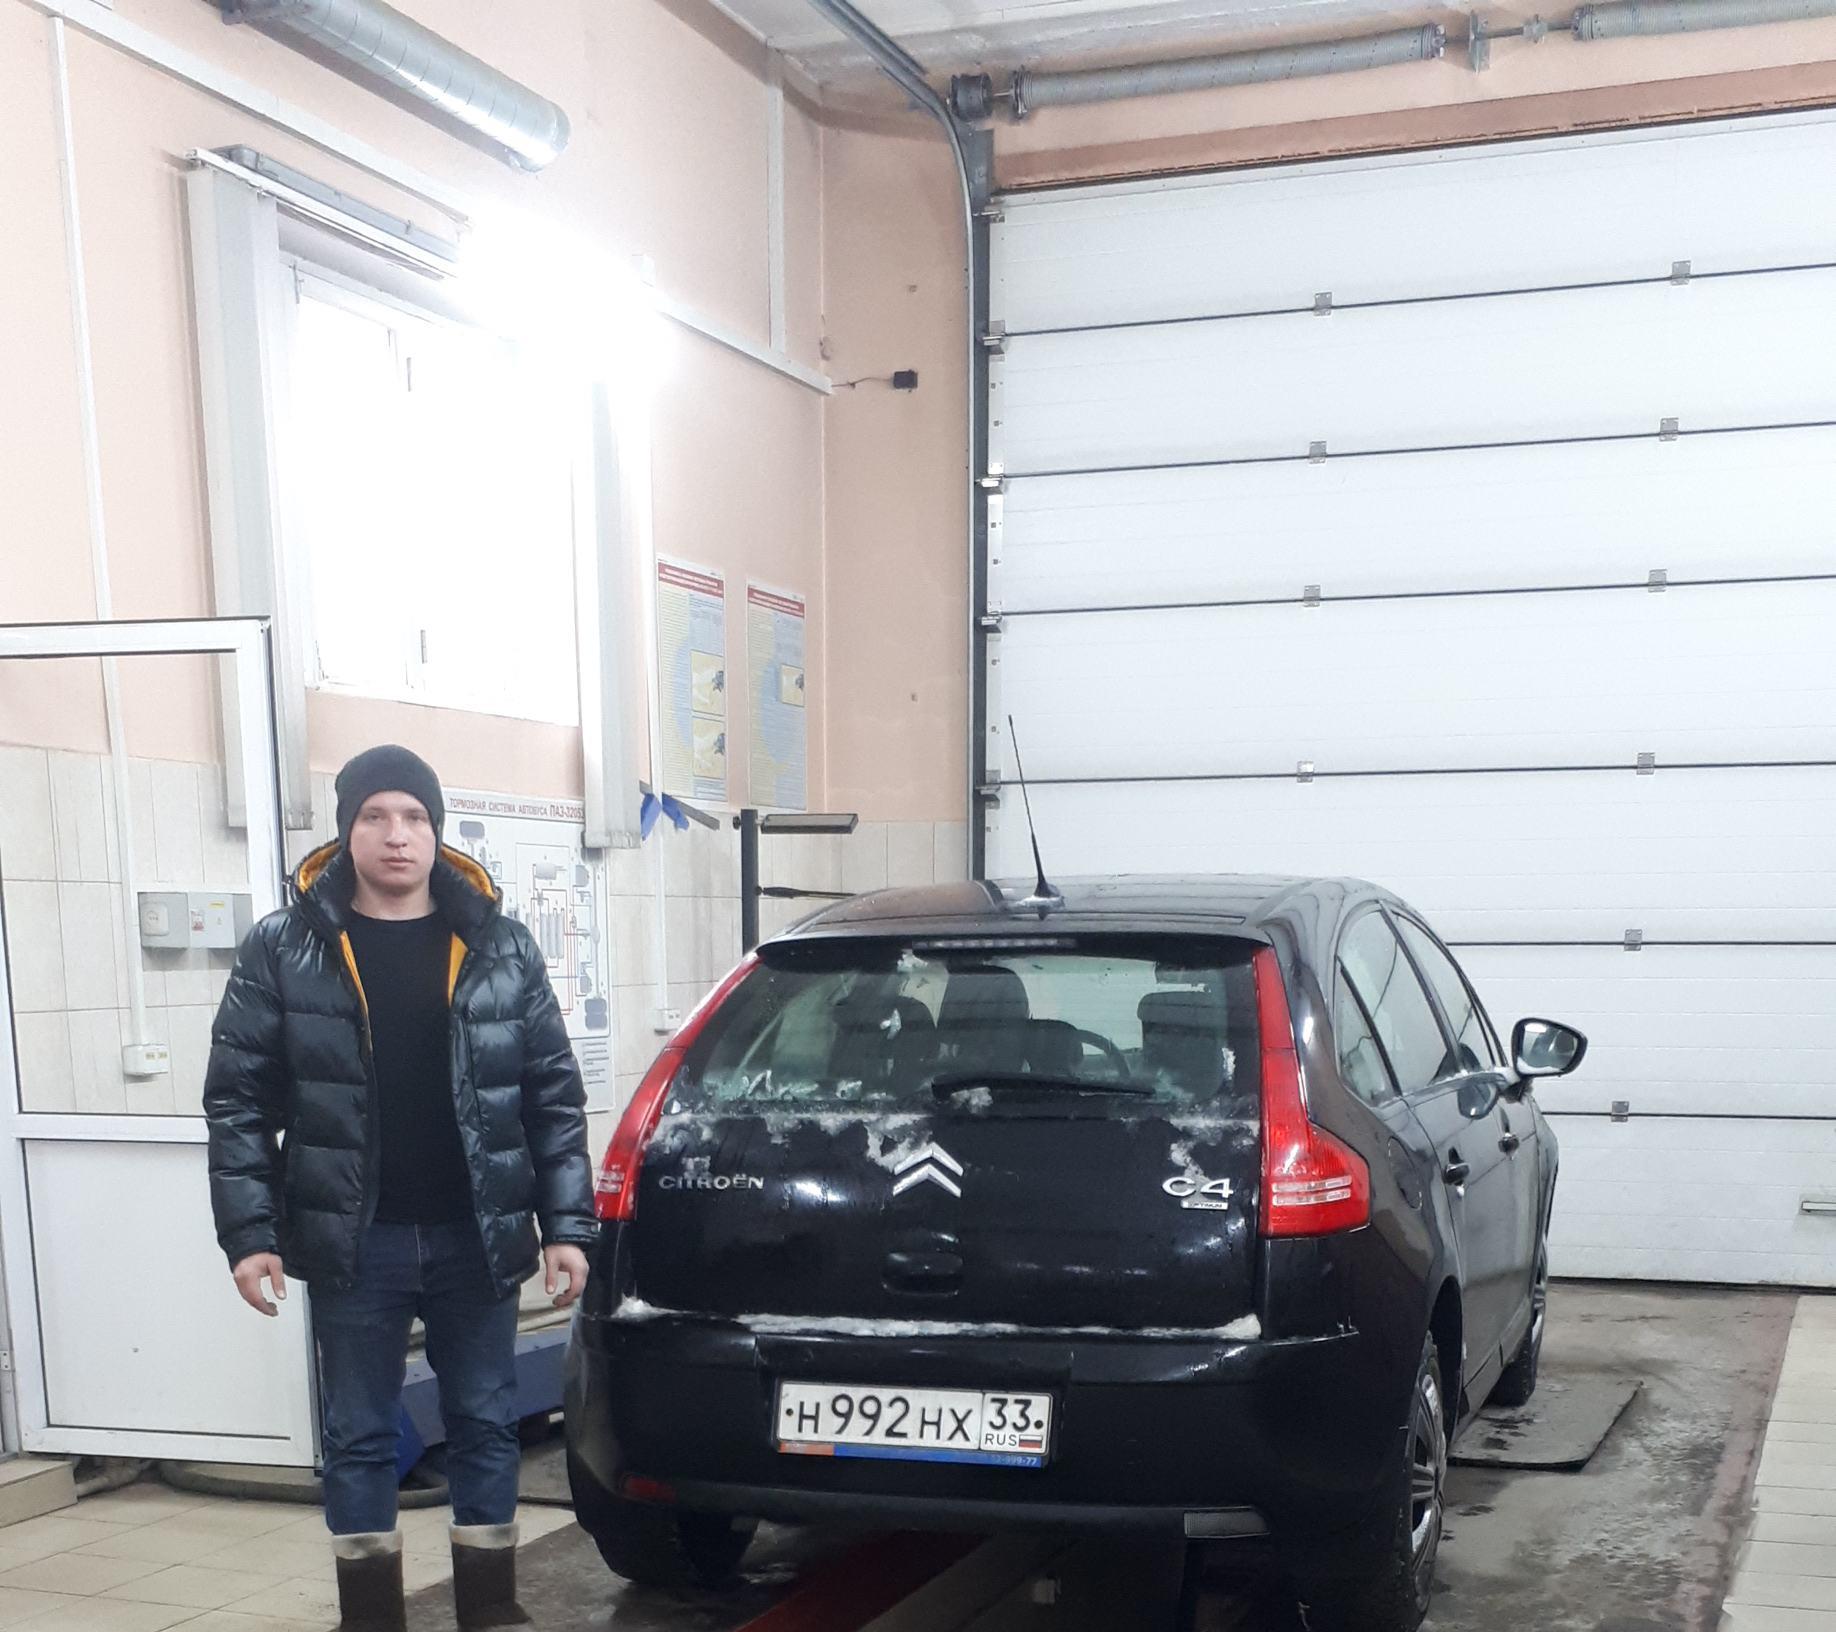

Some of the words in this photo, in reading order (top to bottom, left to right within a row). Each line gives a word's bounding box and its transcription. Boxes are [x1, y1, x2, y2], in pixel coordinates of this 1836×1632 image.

[449, 797, 486, 809] ТОРМОЗНАЯ
[489, 801, 516, 813] СИСТЕМА
[519, 804, 547, 816] АВТОБУСА
[1162, 1176, 1234, 1199] C4
[988, 1397, 1031, 1432] 33
[984, 1433, 1018, 1447] RUS
